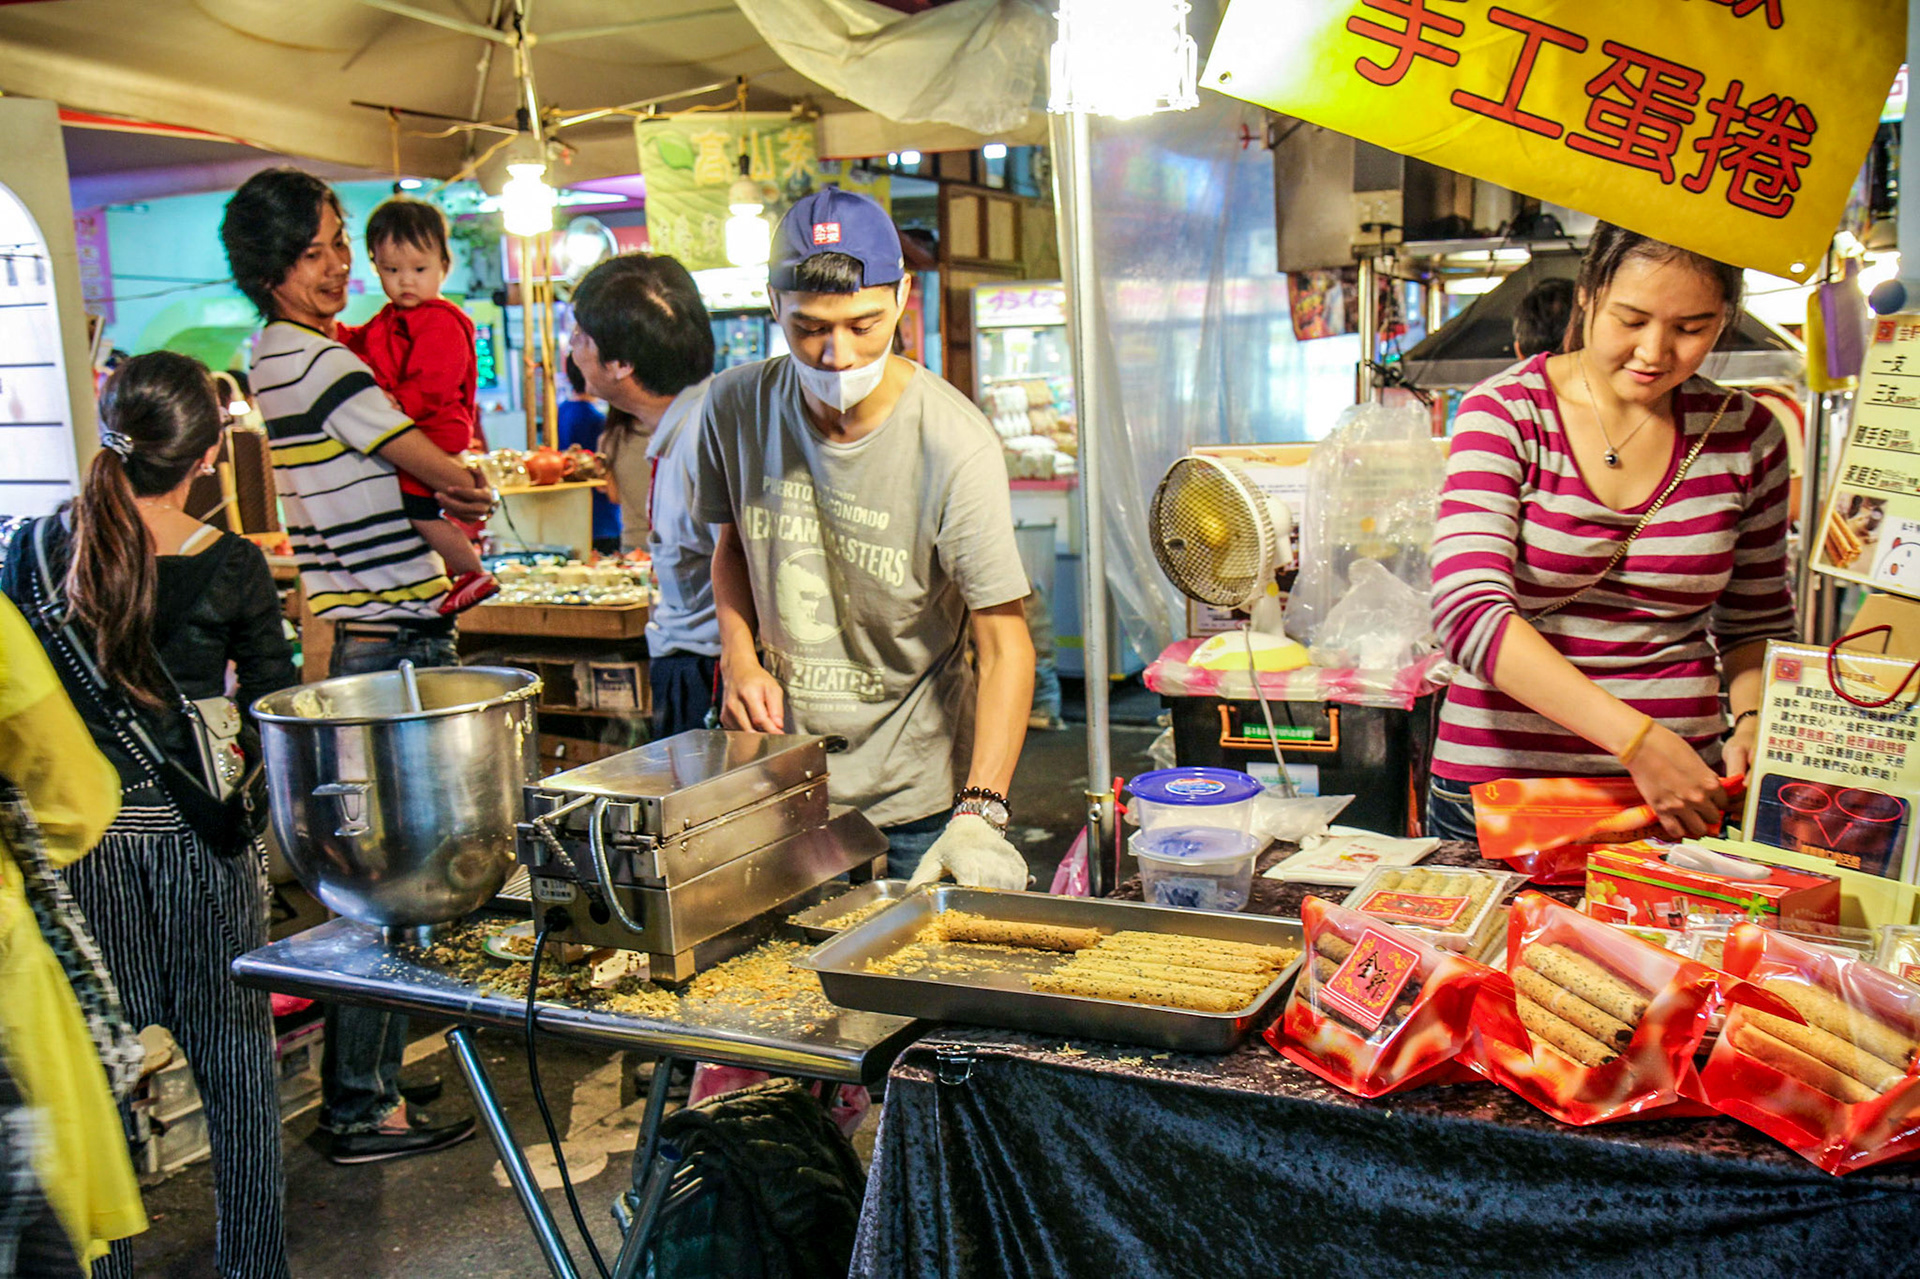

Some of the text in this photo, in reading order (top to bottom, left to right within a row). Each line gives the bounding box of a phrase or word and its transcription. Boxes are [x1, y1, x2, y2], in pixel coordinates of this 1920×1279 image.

[1346, 0, 1817, 218] 手工蛋捲
[1882, 355, 1907, 372] 一支
[1871, 384, 1899, 403] 三支
[763, 476, 813, 502] PUERTO
